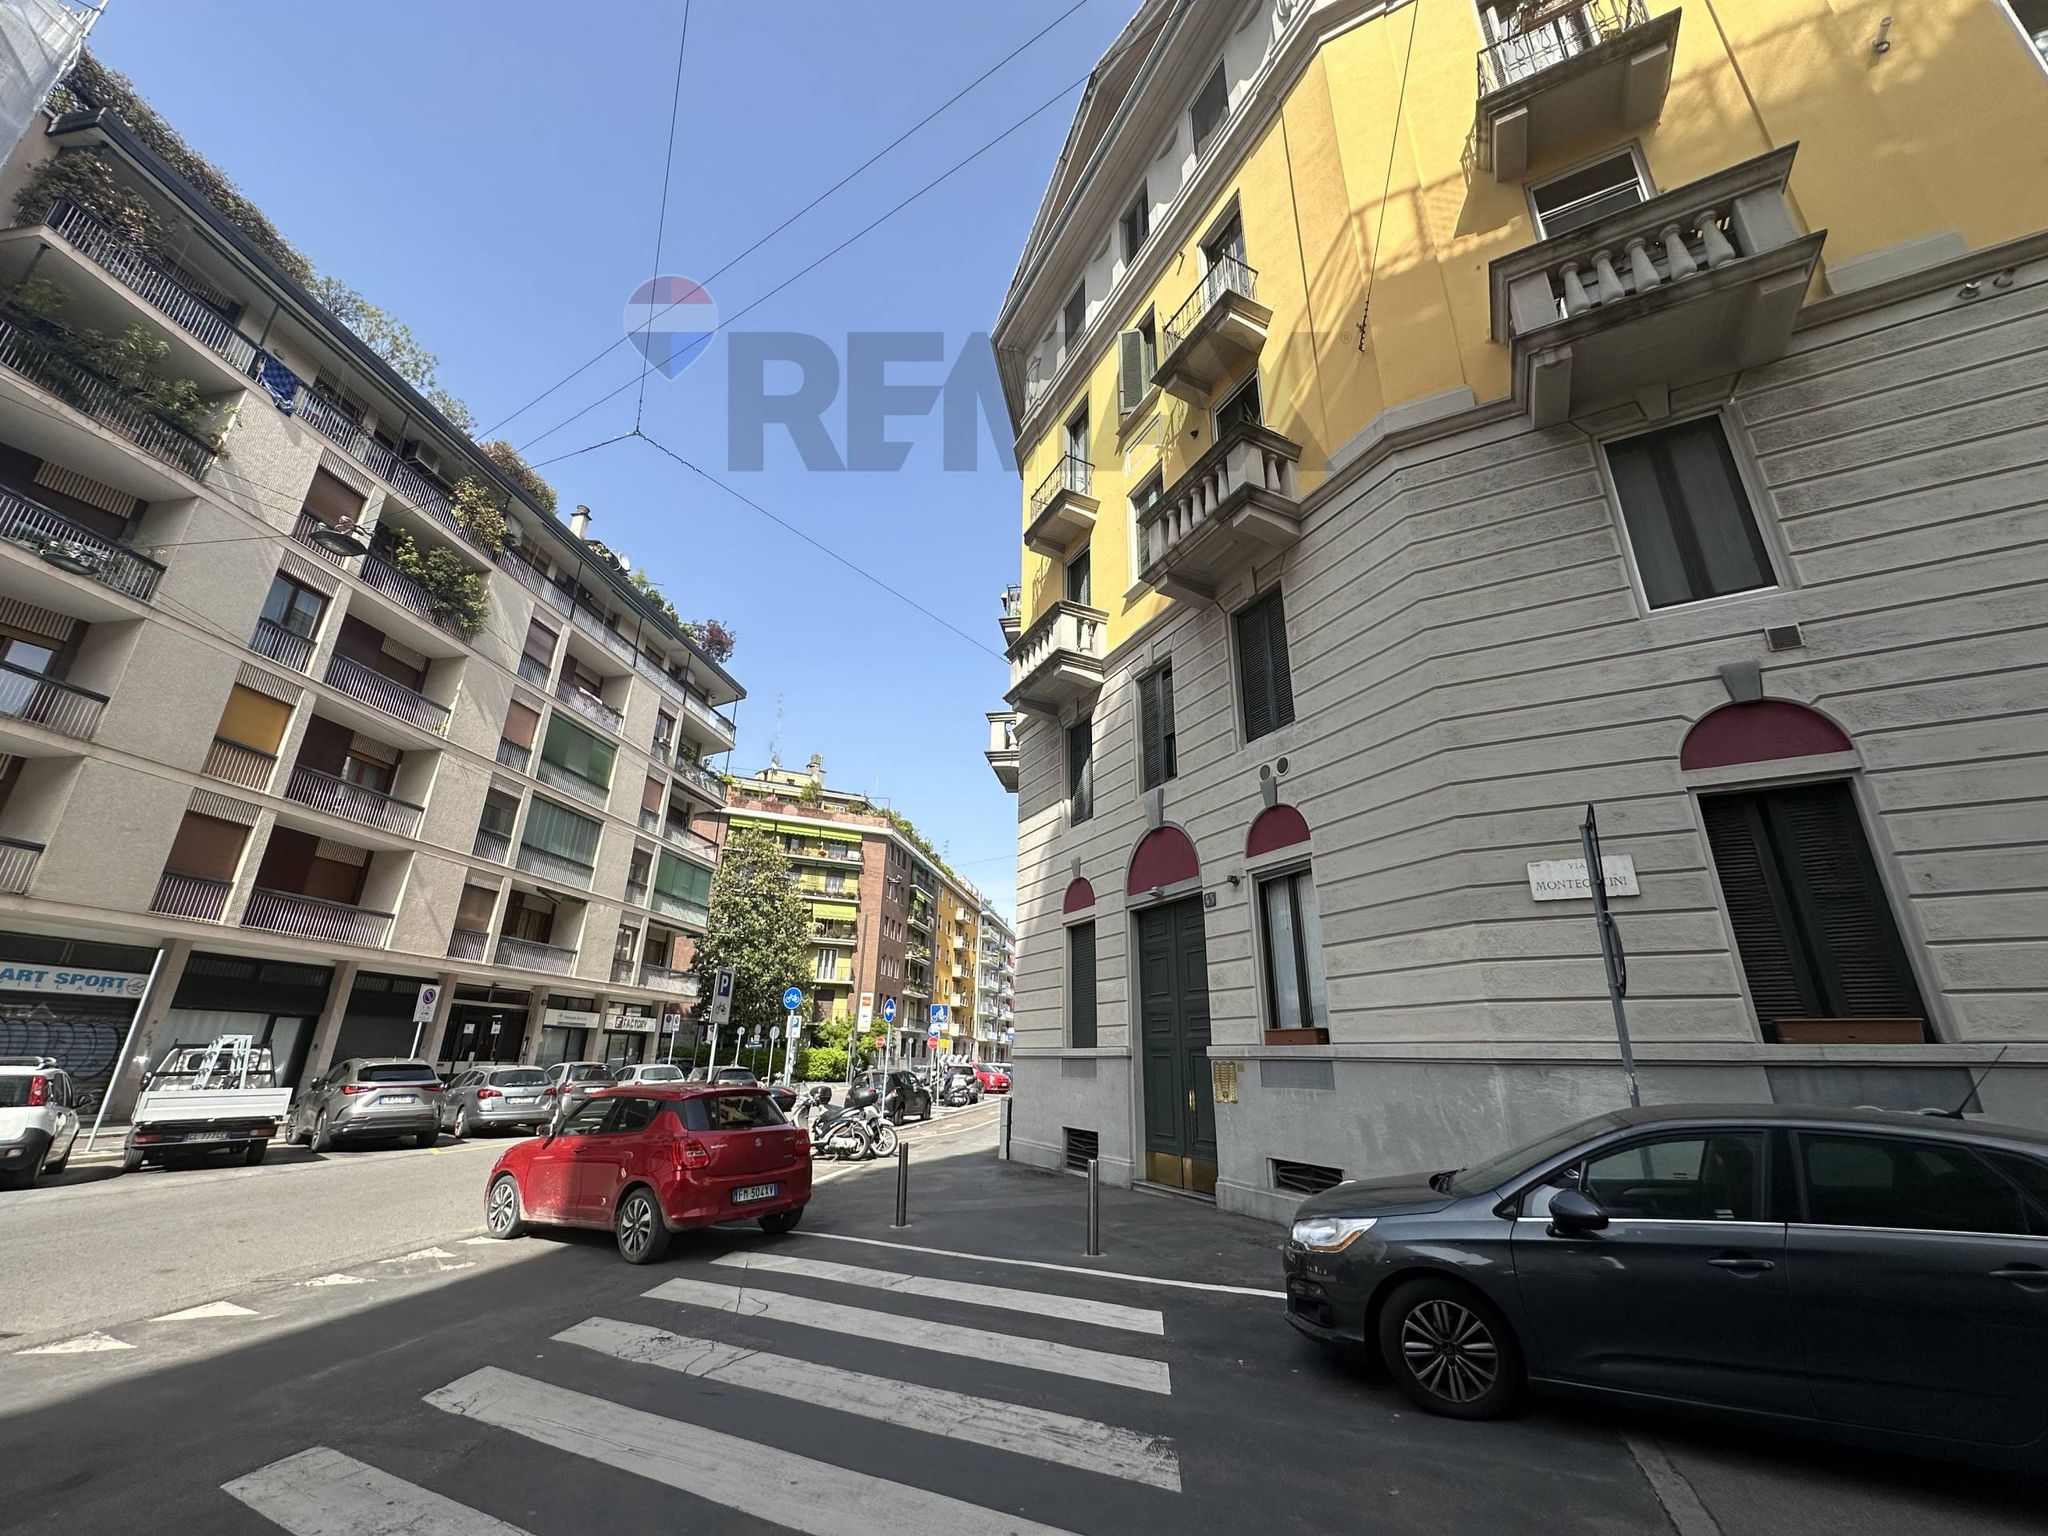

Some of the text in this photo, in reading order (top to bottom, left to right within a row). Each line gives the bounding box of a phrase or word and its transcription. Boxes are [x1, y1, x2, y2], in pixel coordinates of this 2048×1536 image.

[1567, 862, 1586, 870] VIA
[0, 967, 49, 982] ART
[54, 972, 129, 989] SPORT
[720, 974, 729, 993] P
[623, 1017, 648, 1029] FACTORY
